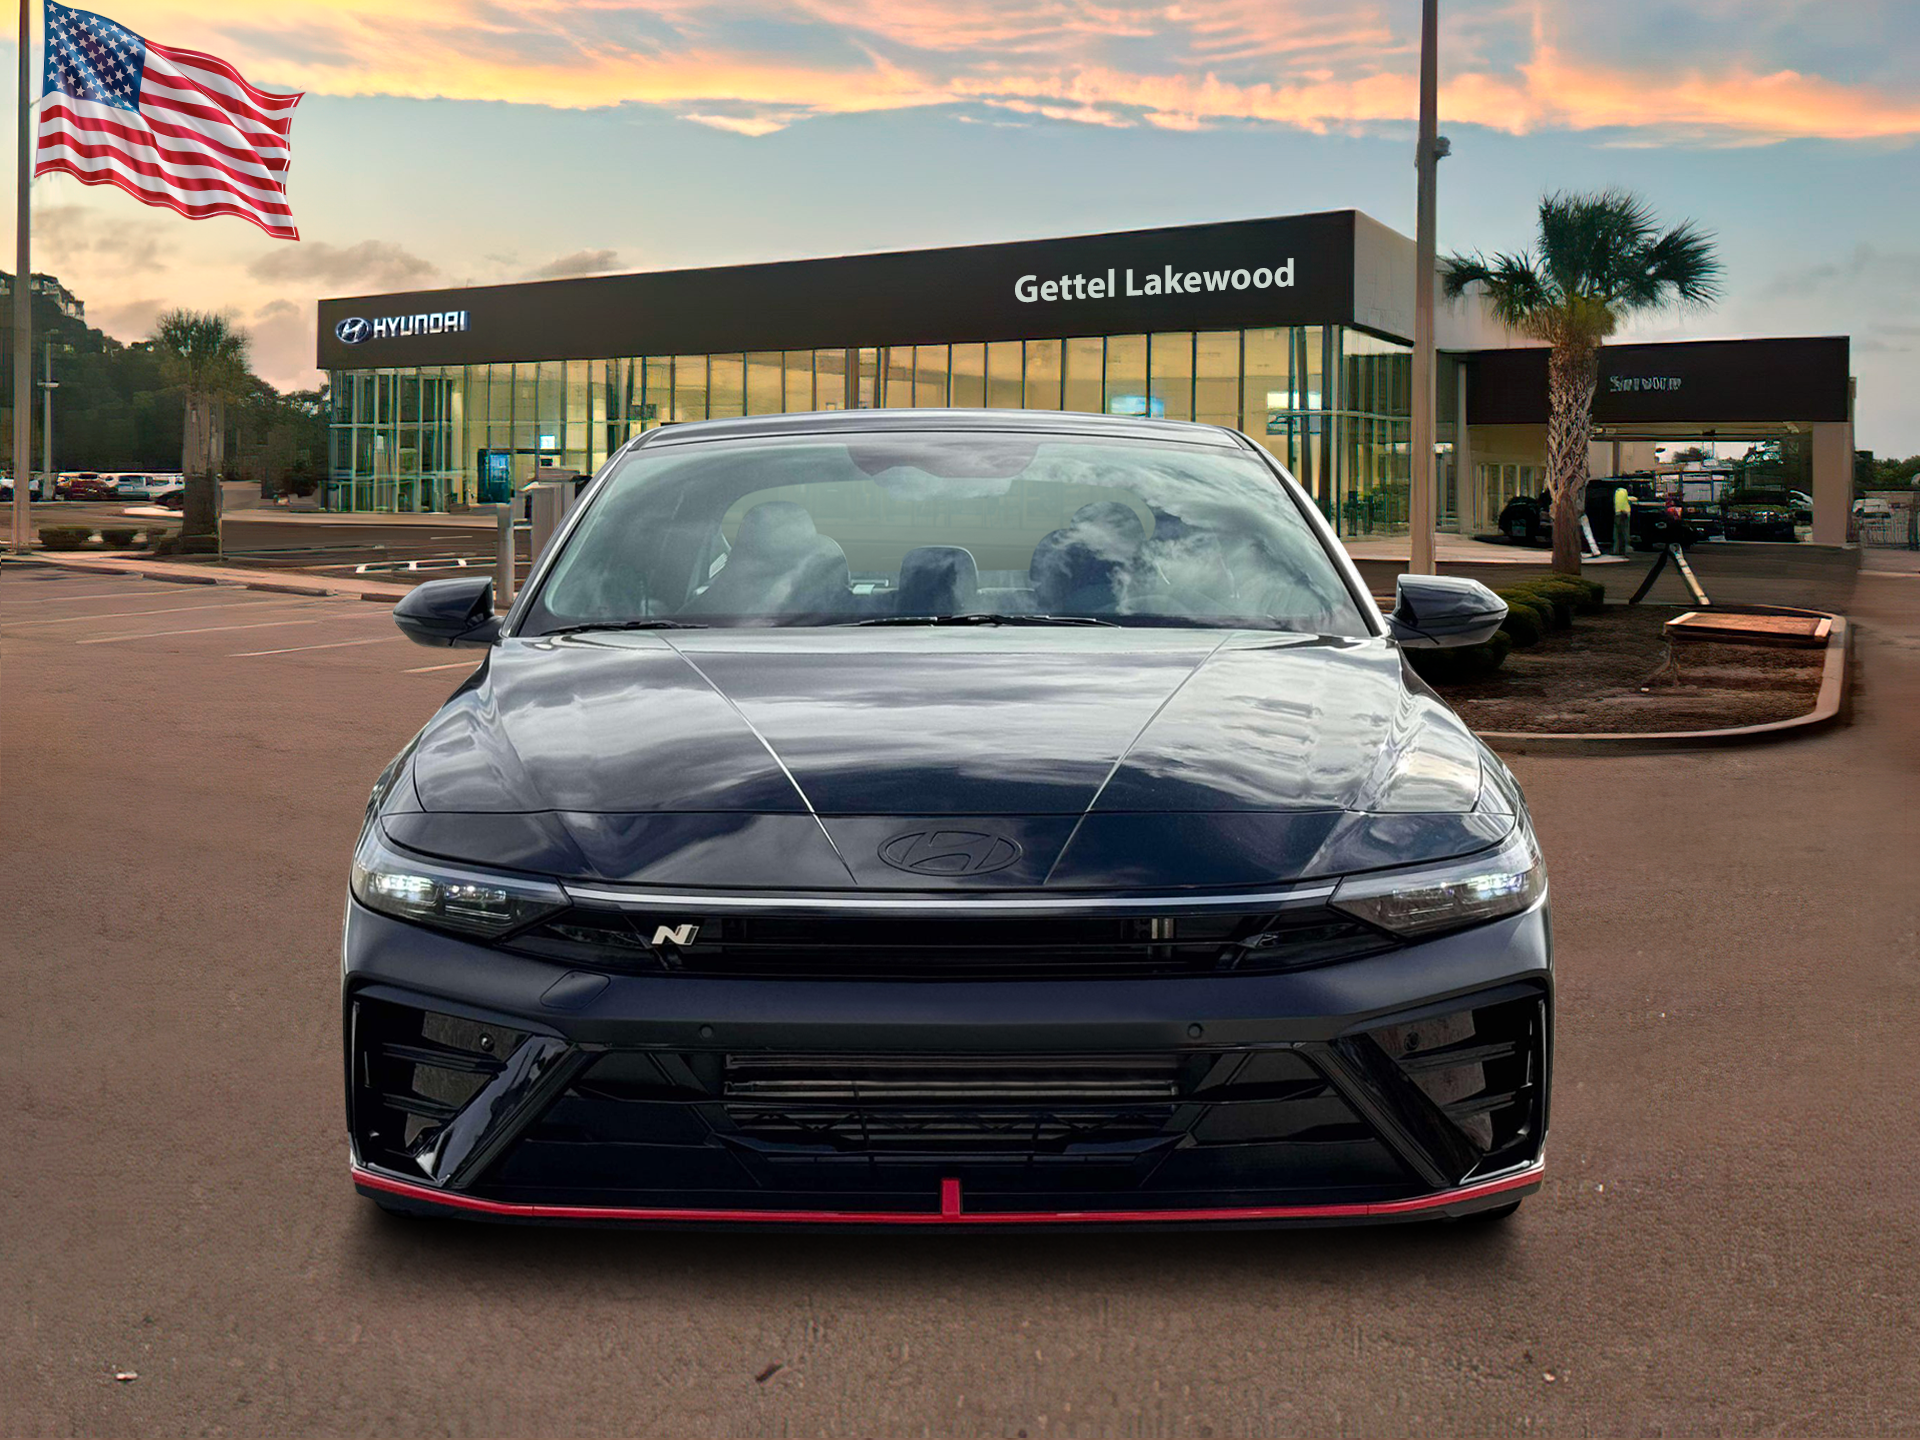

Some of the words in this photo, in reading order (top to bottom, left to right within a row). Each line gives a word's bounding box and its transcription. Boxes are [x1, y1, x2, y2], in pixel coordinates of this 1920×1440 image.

[1014, 268, 1115, 303] Gettel
[1126, 257, 1295, 297] Lakewood
[373, 310, 468, 339] HYUNDAI
